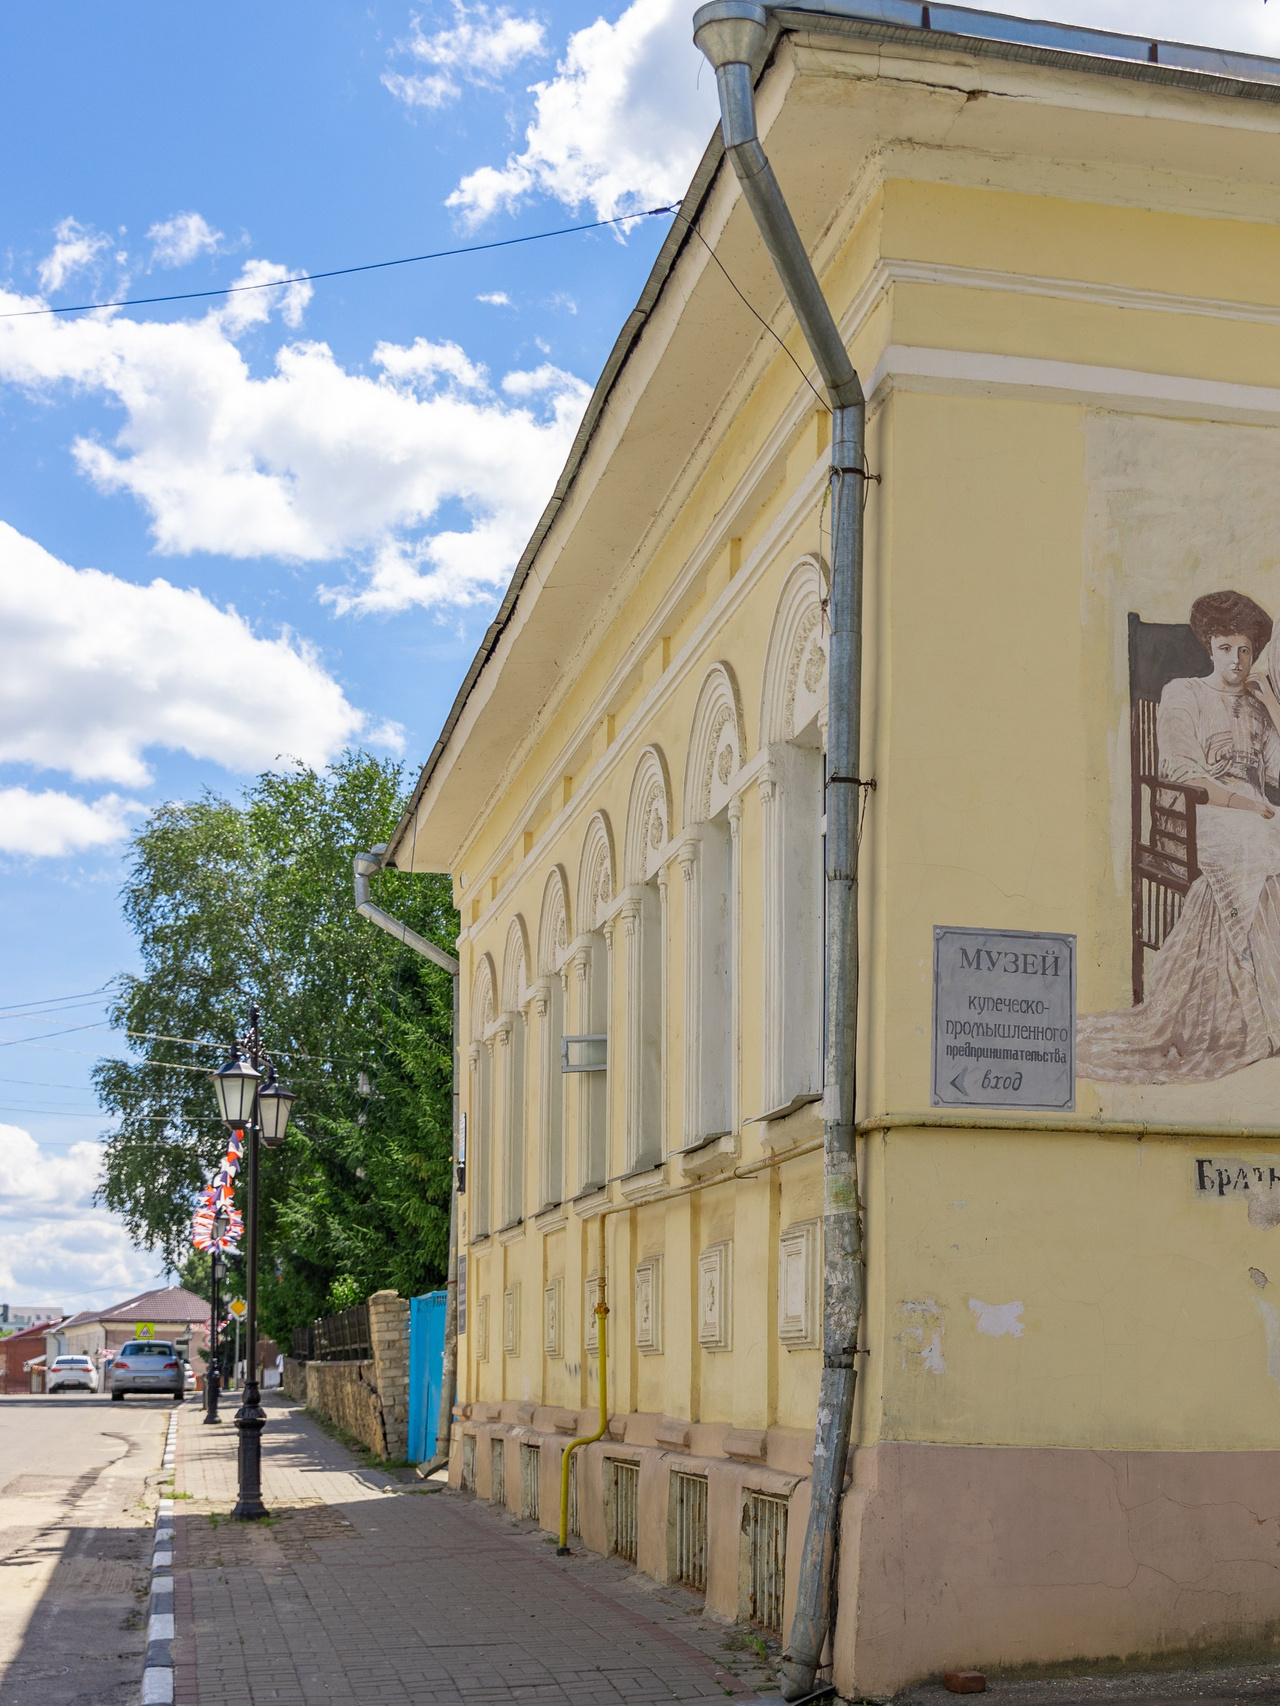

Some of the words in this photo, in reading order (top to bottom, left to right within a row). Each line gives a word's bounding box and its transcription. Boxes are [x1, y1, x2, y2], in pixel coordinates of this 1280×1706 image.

[959, 947, 1061, 977] МУЗЕЙ
[968, 995, 1050, 1015] купеческо-
[945, 1019, 1068, 1042] промышленного
[946, 1041, 1067, 1064] предпринимательства
[981, 1068, 1023, 1092] вход
